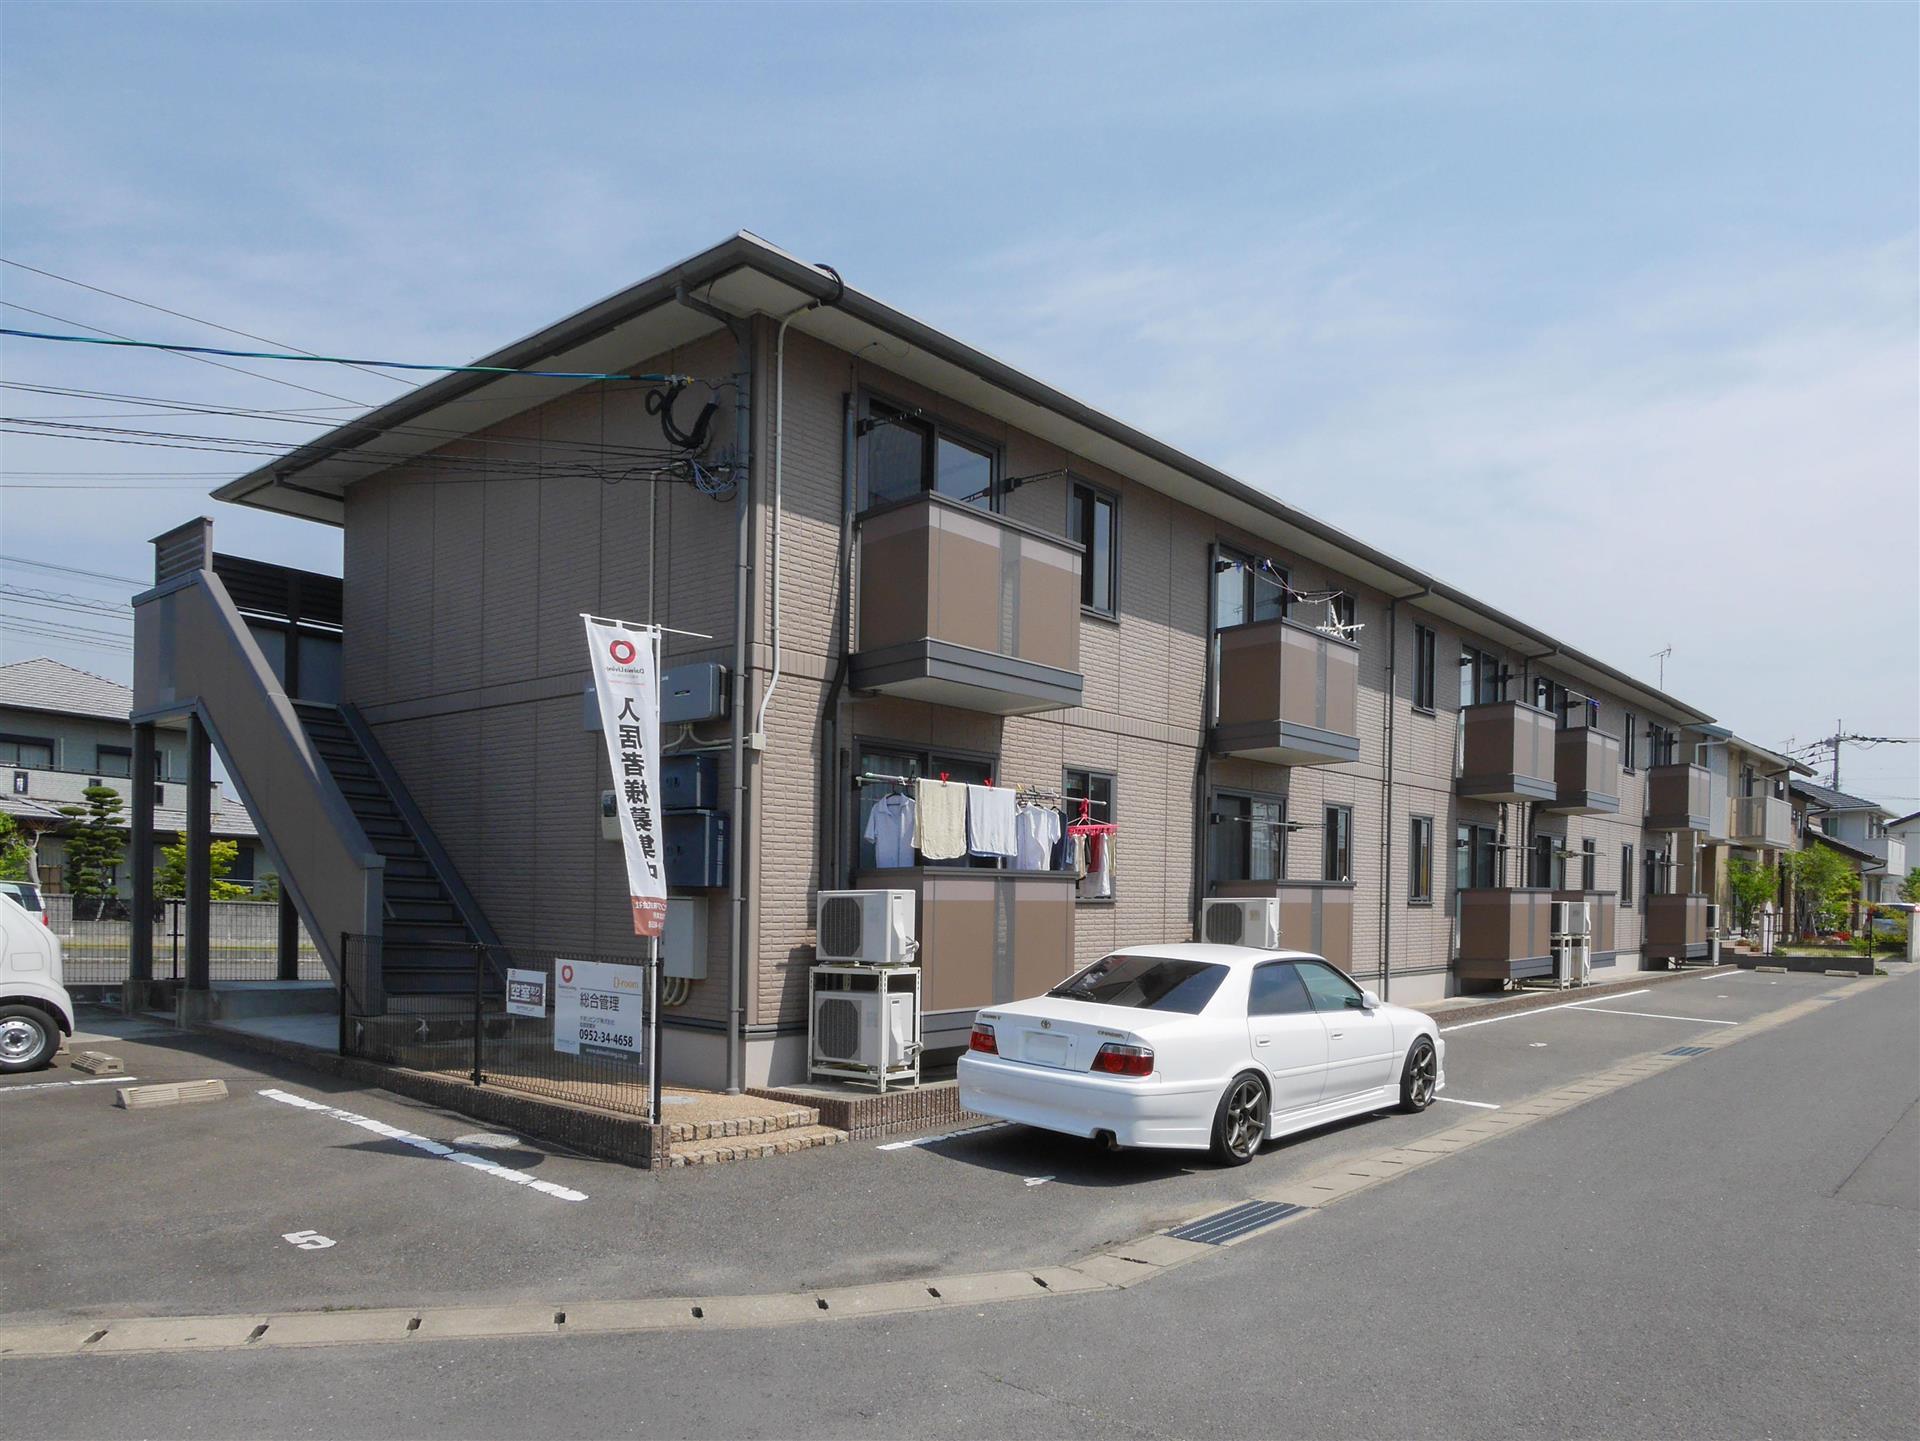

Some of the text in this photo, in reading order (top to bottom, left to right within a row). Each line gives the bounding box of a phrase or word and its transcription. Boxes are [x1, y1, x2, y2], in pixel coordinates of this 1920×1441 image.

[580, 992, 620, 1012] 総合管理
[579, 1029, 633, 1047] 0952-34-4658
[281, 1230, 337, 1250] 5
